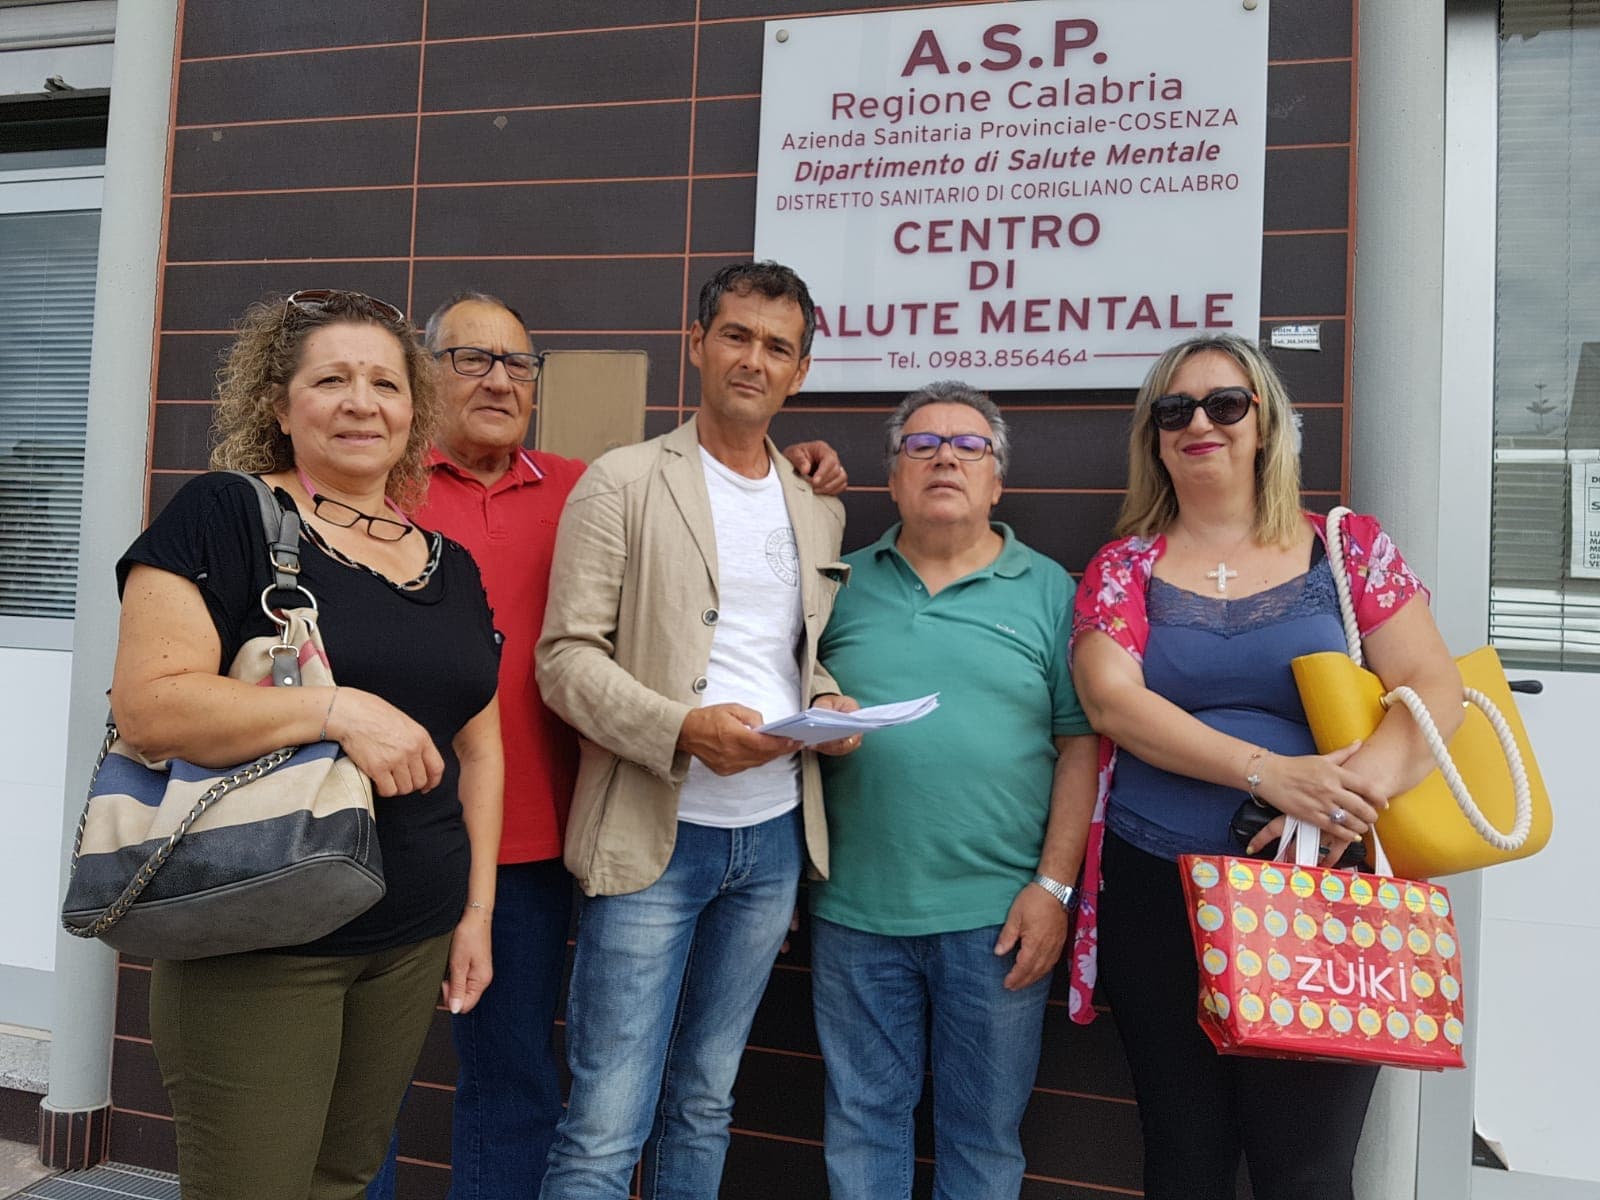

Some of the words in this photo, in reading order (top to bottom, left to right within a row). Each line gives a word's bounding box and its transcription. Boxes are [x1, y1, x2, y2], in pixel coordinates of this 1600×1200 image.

[901, 19, 1108, 77] A.S.P.
[831, 88, 992, 124] Regione
[1008, 73, 1183, 109] Calabria
[782, 130, 866, 151] Azienda
[874, 123, 971, 146] Sanitaria
[980, 108, 1239, 140] Provinciale-COSENZA
[795, 157, 965, 184] Dipartimento
[975, 150, 999, 174] di
[1008, 147, 1096, 172] Salute
[1106, 140, 1220, 166] Mentale
[776, 191, 874, 211] DISTRETTO
[879, 186, 980, 207] SANITARIO
[986, 184, 1004, 202] DI
[1011, 178, 1133, 200] CORIGLIANO
[1140, 173, 1240, 195] CALABRO
[893, 213, 1101, 255] CENTRO
[969, 259, 1016, 291] DI
[812, 301, 960, 338] ALUTE
[980, 293, 1234, 335] MENTALE
[887, 351, 922, 369] Tel.
[928, 349, 1088, 368] 0983.856464
